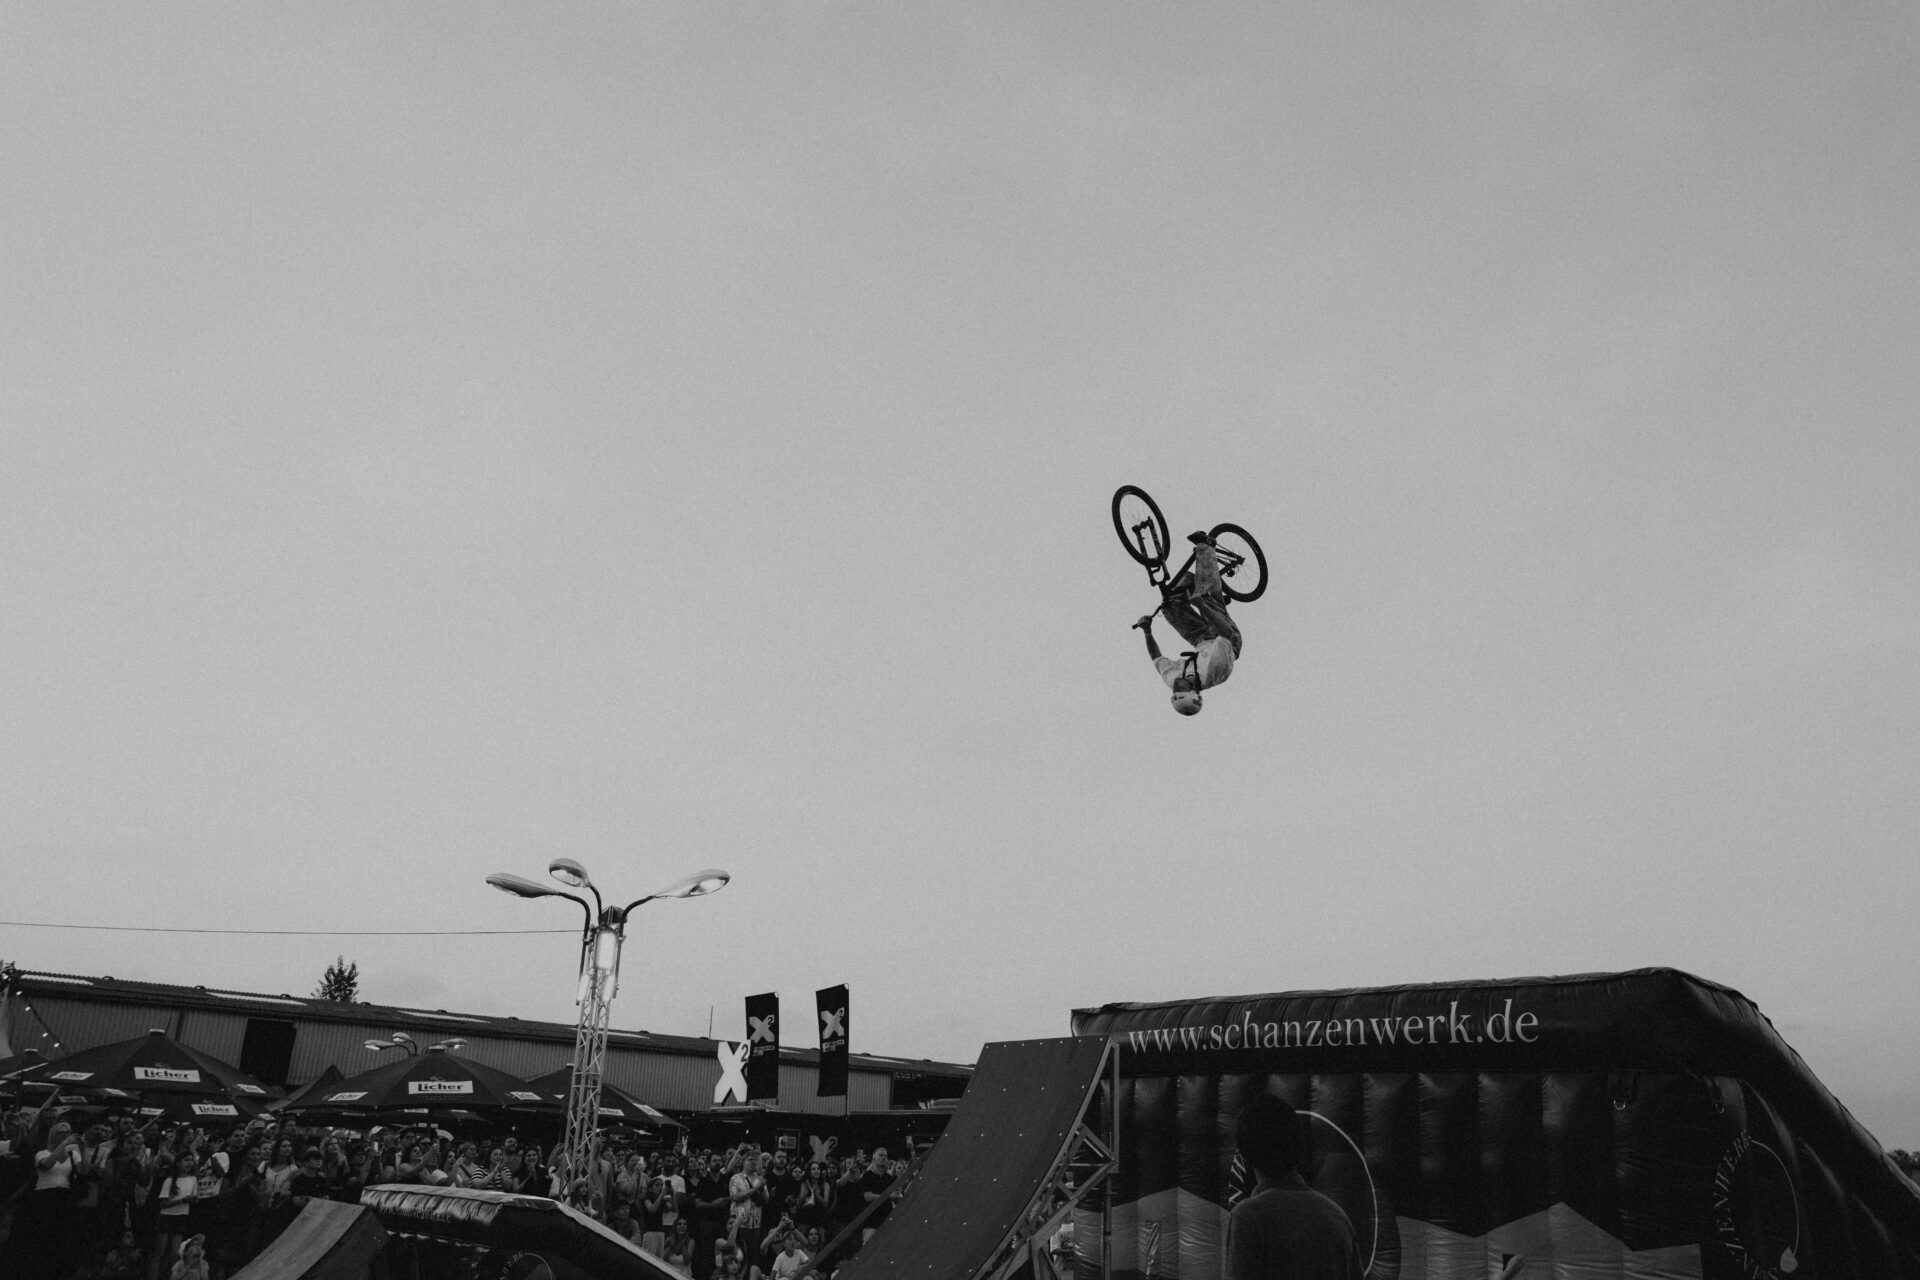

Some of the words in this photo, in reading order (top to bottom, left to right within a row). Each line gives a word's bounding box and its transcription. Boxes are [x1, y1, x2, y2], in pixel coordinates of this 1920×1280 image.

[1128, 998, 1540, 1054] www.schanzenwerk.de
[143, 1069, 190, 1079] Licher
[418, 1083, 463, 1092] Licher
[198, 1105, 229, 1113] Licher
